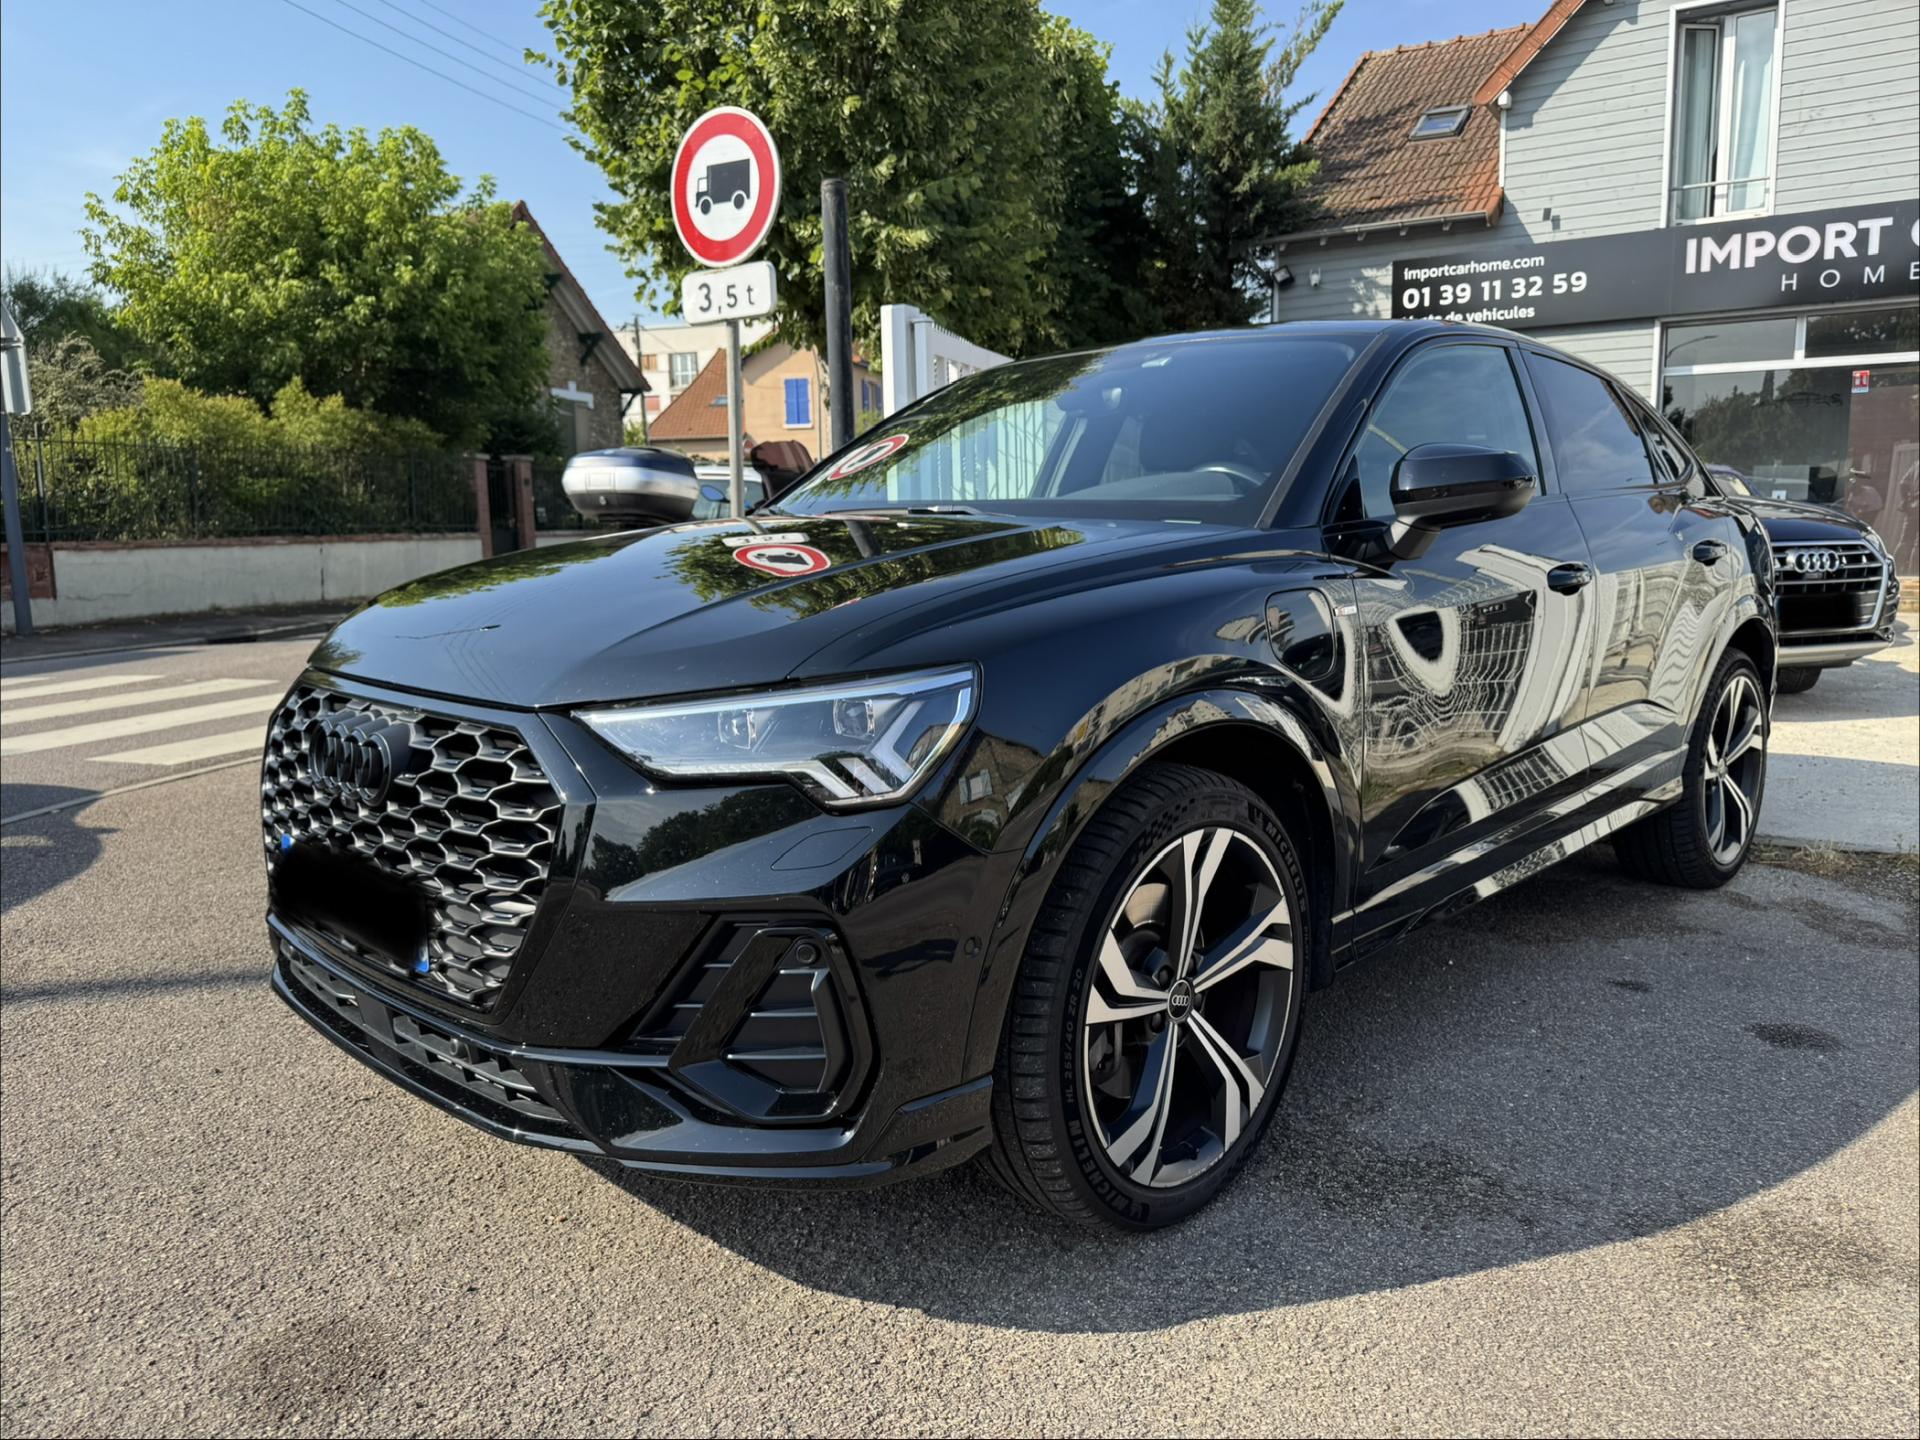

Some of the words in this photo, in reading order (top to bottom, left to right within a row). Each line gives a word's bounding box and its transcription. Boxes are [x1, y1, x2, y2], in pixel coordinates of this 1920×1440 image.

[1685, 217, 1894, 274] IMPORT
[1403, 255, 1545, 282] importcarhome.com
[698, 283, 738, 315] 3,5
[746, 284, 755, 305] t
[1402, 286, 1431, 310] 01
[1439, 282, 1472, 306] 39
[1480, 279, 1502, 302] 11
[1511, 275, 1544, 299] 32
[1552, 271, 1588, 295] 59
[1067, 1120, 1133, 1212] MICHELIN
